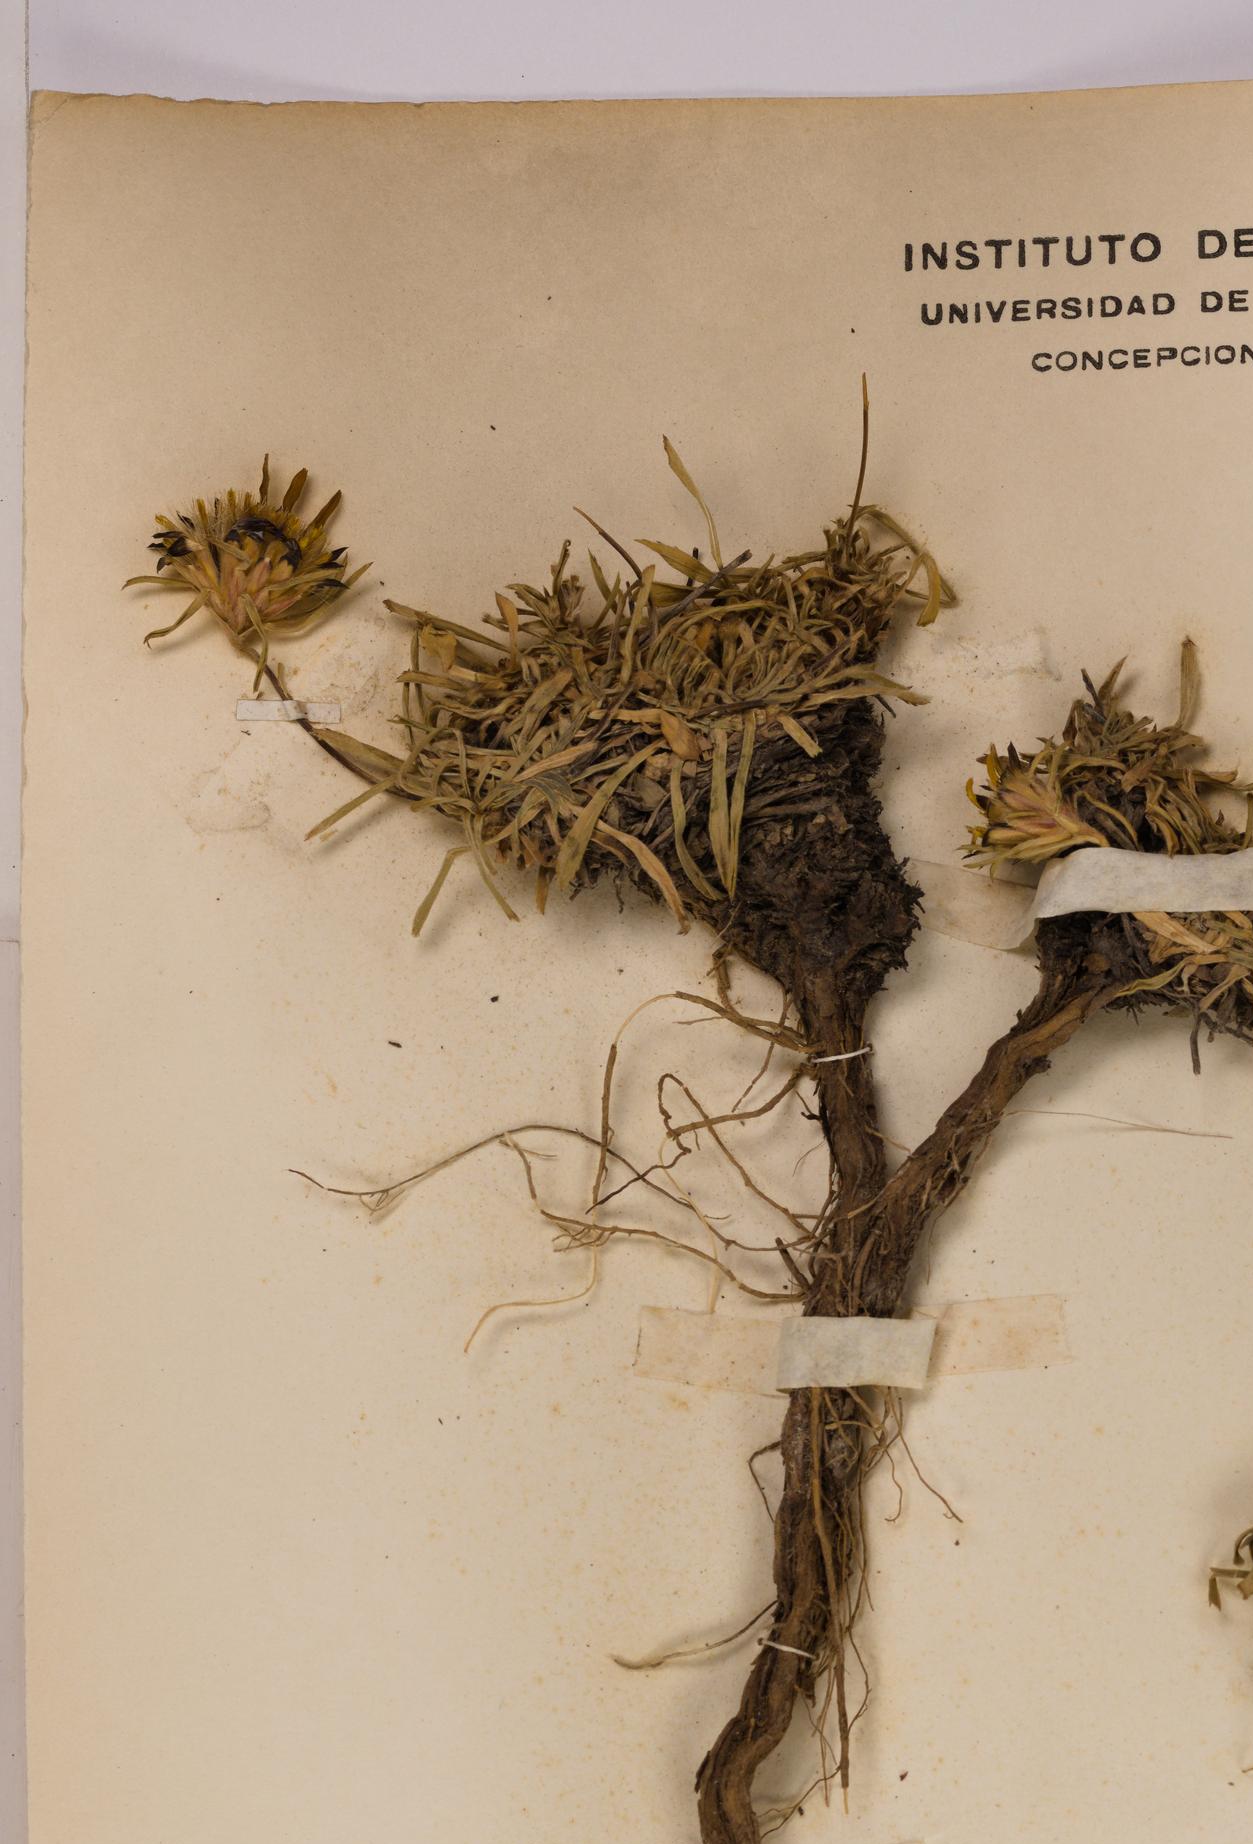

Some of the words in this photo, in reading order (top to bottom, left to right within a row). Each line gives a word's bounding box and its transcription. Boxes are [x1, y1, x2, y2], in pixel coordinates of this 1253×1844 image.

[904, 232, 1162, 272] INSTITUTO
[920, 292, 1176, 326] UNIVERSIDAD
[1200, 289, 1249, 313] DE
